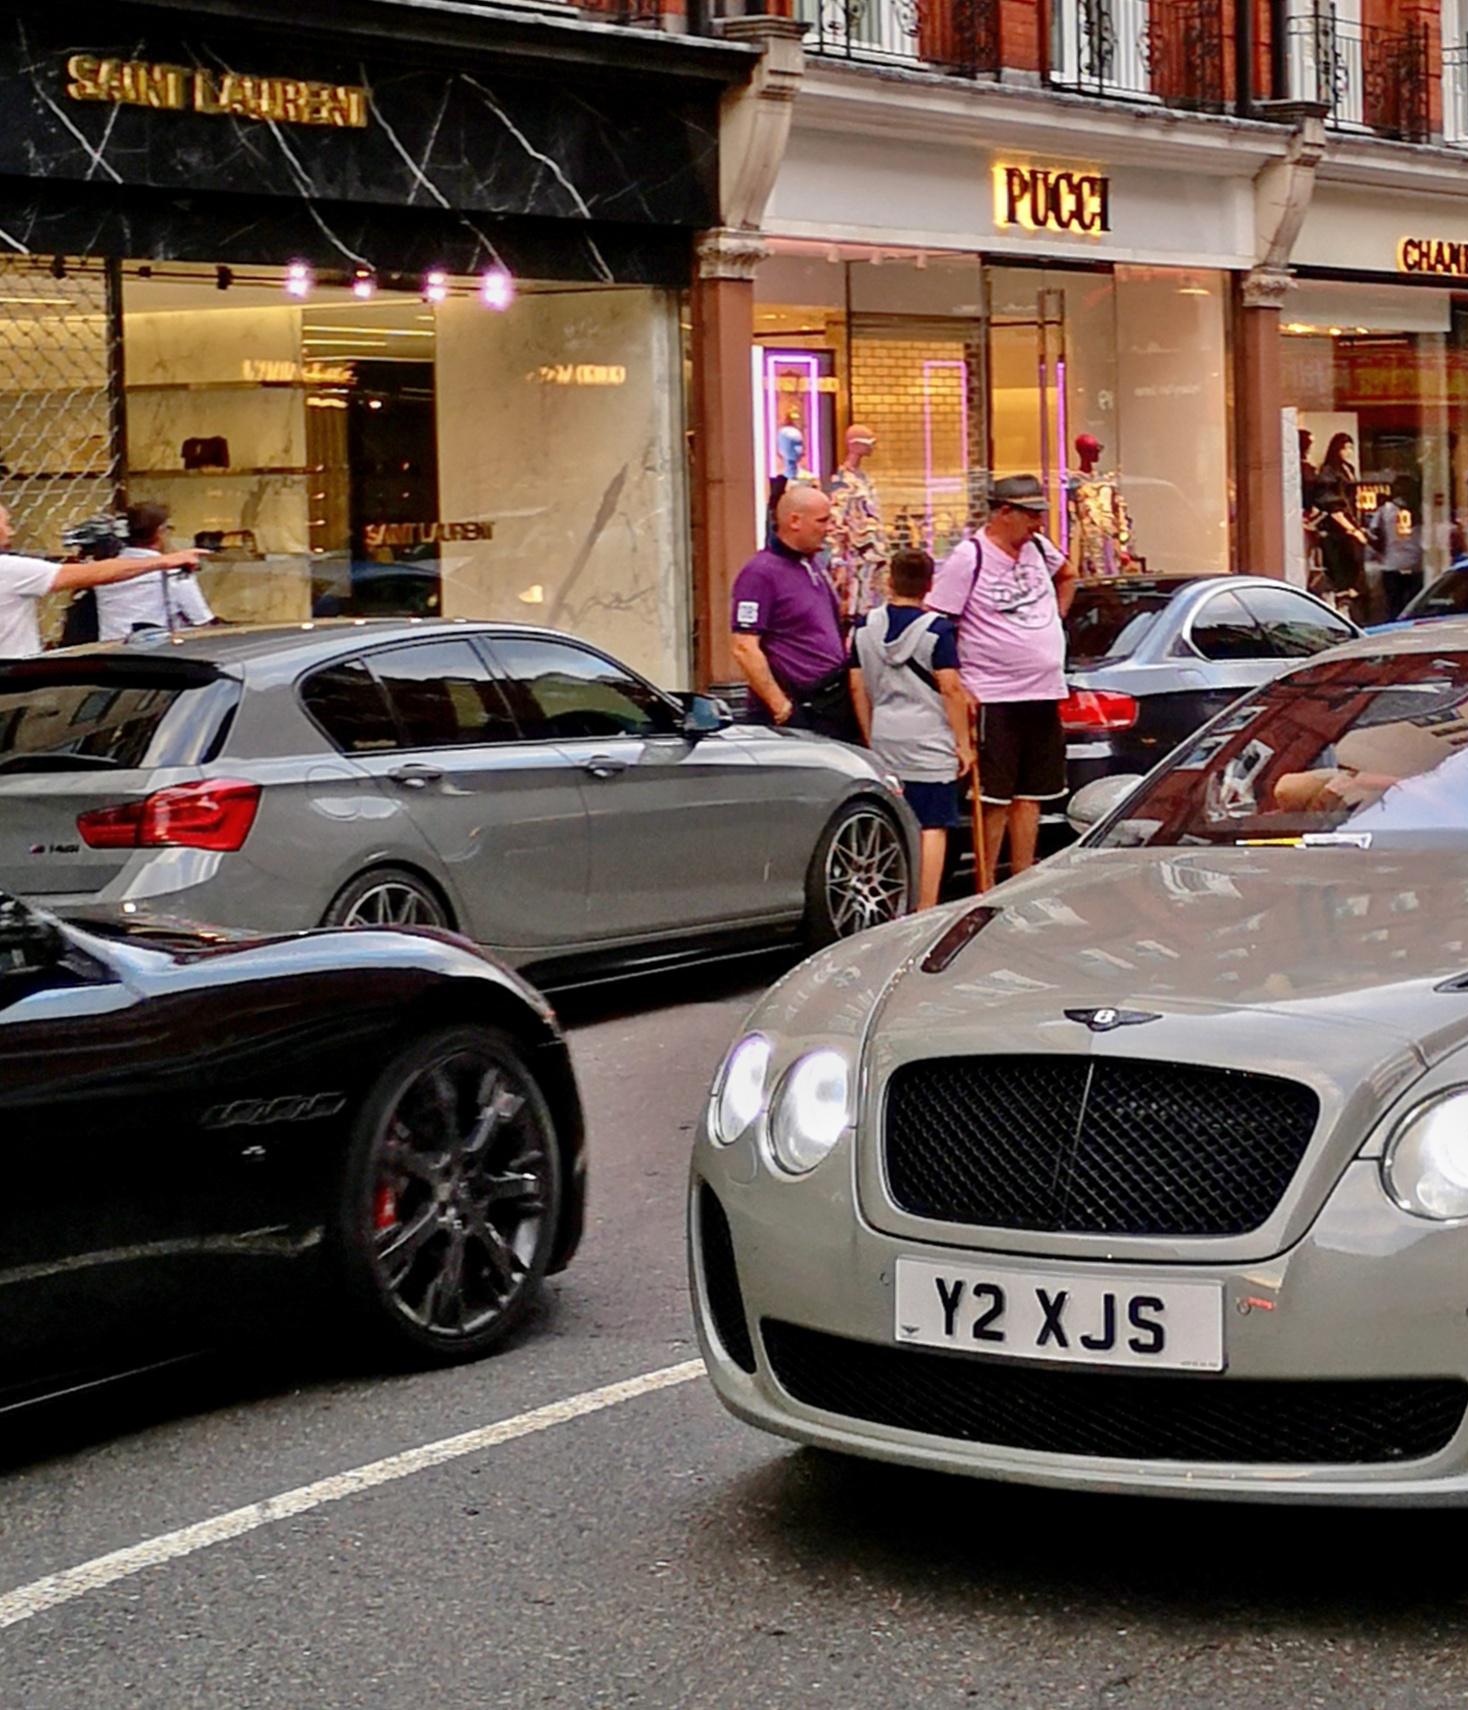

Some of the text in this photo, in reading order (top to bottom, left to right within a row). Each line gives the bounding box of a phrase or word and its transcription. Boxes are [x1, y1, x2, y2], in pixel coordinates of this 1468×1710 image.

[66, 54, 370, 127] SAINT LAURENT
[1002, 166, 1112, 232] PUCCI
[364, 521, 497, 546] SAINT LAURENT
[934, 1276, 1165, 1354] Y2 XJS
